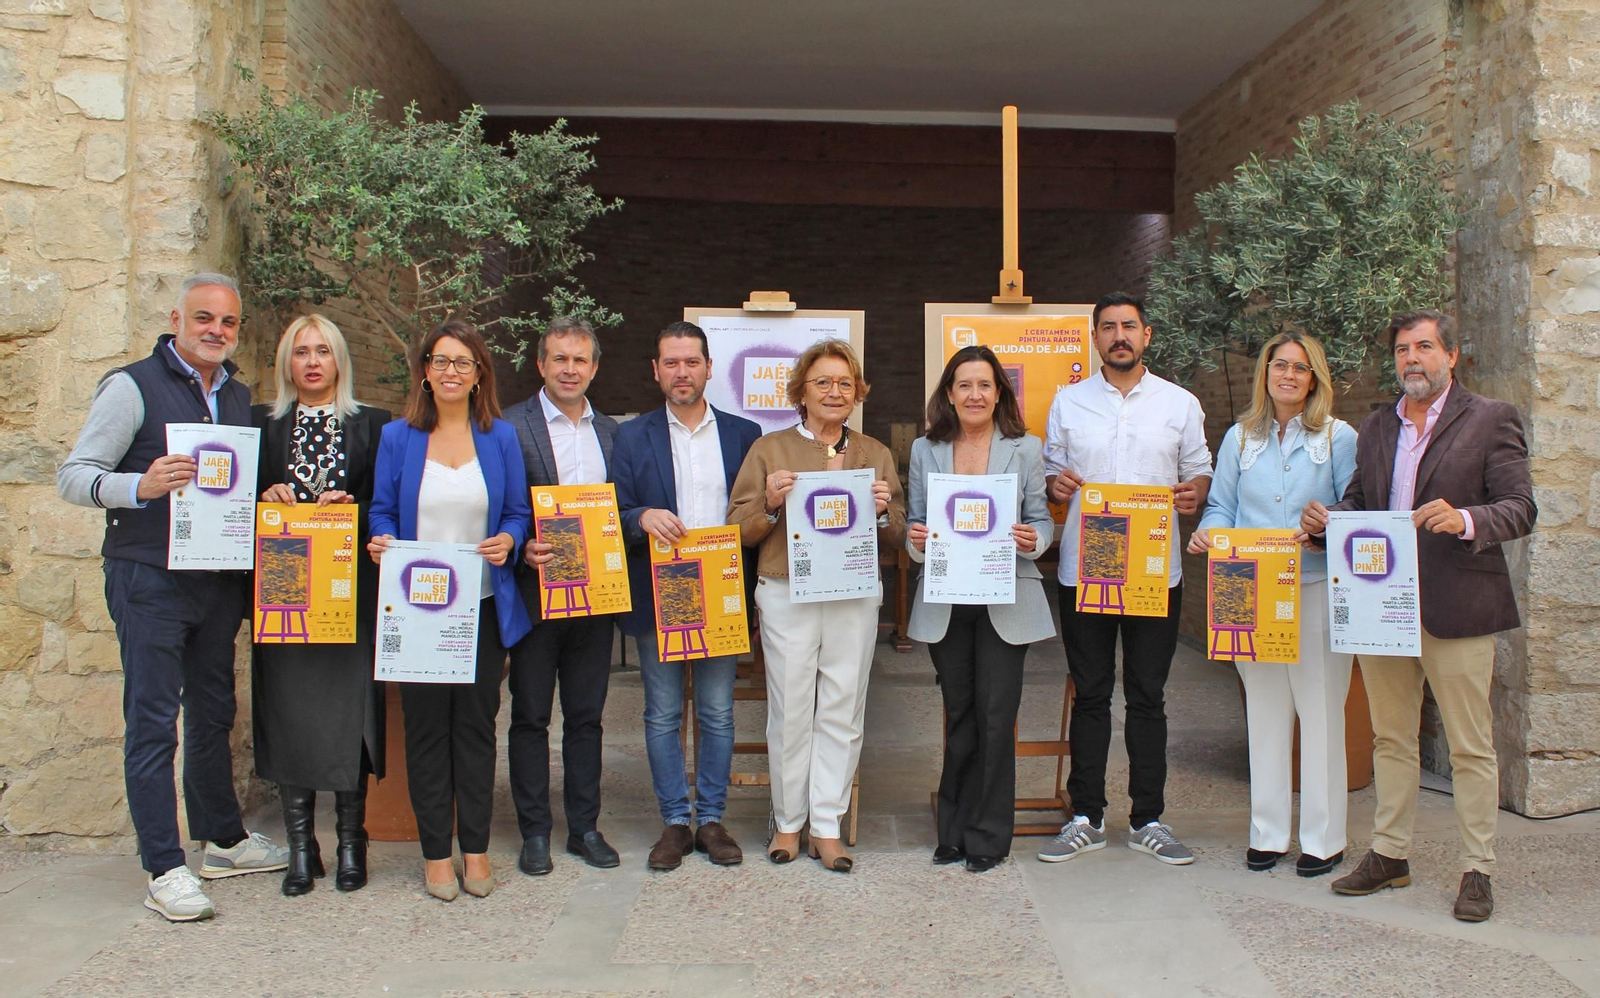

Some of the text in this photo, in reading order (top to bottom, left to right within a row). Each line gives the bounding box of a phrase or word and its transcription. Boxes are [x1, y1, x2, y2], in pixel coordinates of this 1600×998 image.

[992, 343, 1081, 353] CIUDAD DE JAÉN
[1069, 375, 1081, 383] 22
[204, 455, 230, 467] JAÉN
[217, 468, 229, 477] SE
[200, 476, 228, 486] PINTA
[820, 498, 846, 510] JAÉN
[960, 502, 987, 512] JAÉN
[974, 513, 986, 521] SE
[818, 518, 847, 527] PINTA
[957, 521, 986, 529] PINTA
[1358, 541, 1384, 553] JAÉN
[1372, 554, 1384, 563] SE
[1355, 563, 1384, 572] PINTA
[417, 572, 447, 583] JAÉN
[432, 585, 446, 593] SE
[412, 593, 445, 602] PINTA
